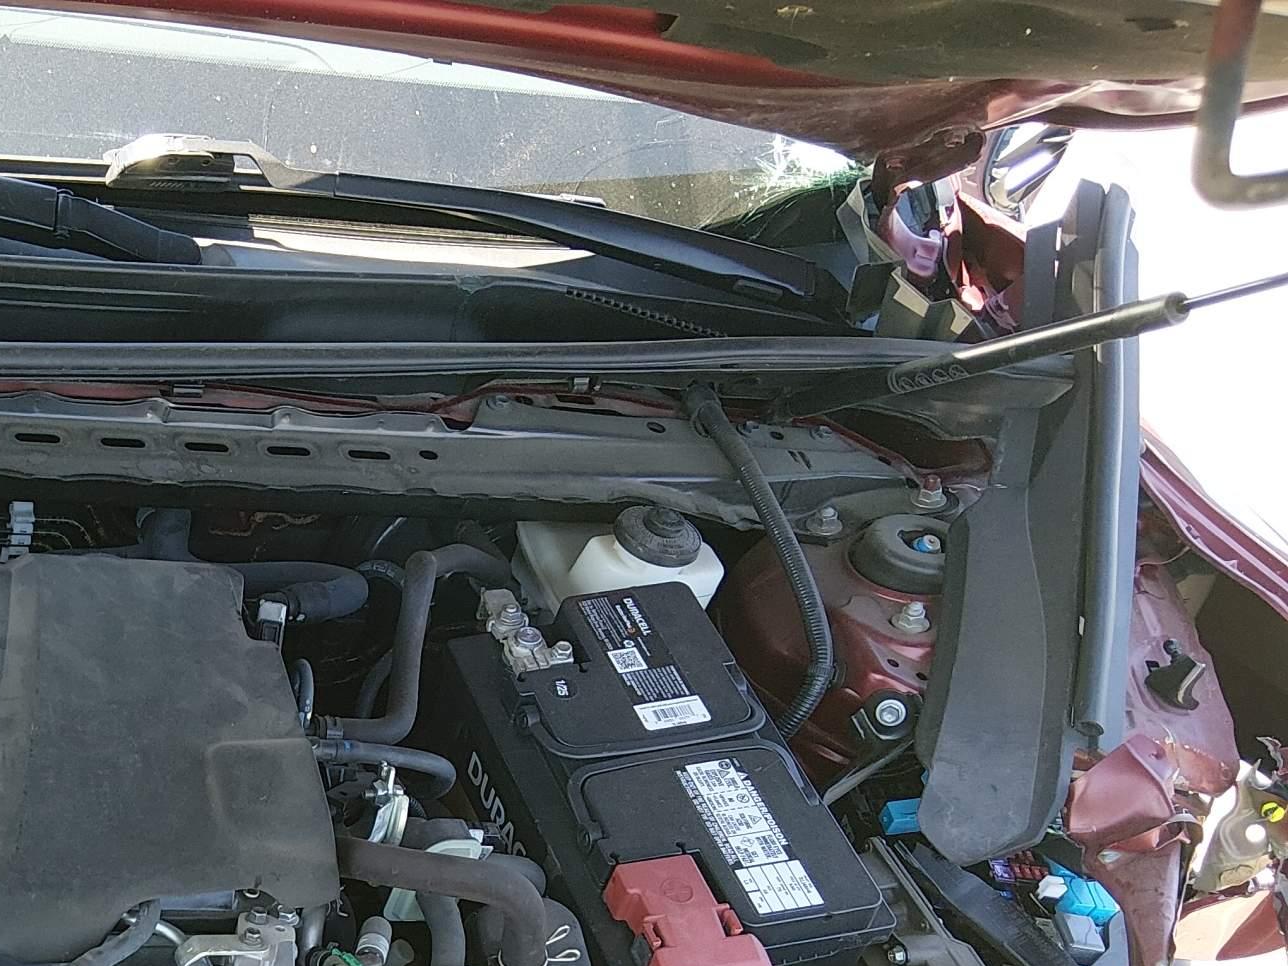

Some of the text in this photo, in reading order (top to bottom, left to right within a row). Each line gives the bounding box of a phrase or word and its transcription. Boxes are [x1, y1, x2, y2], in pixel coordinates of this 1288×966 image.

[623, 597, 652, 636] DURACELL
[555, 679, 569, 696] 1/25
[742, 779, 788, 845] DANGER/POISON
